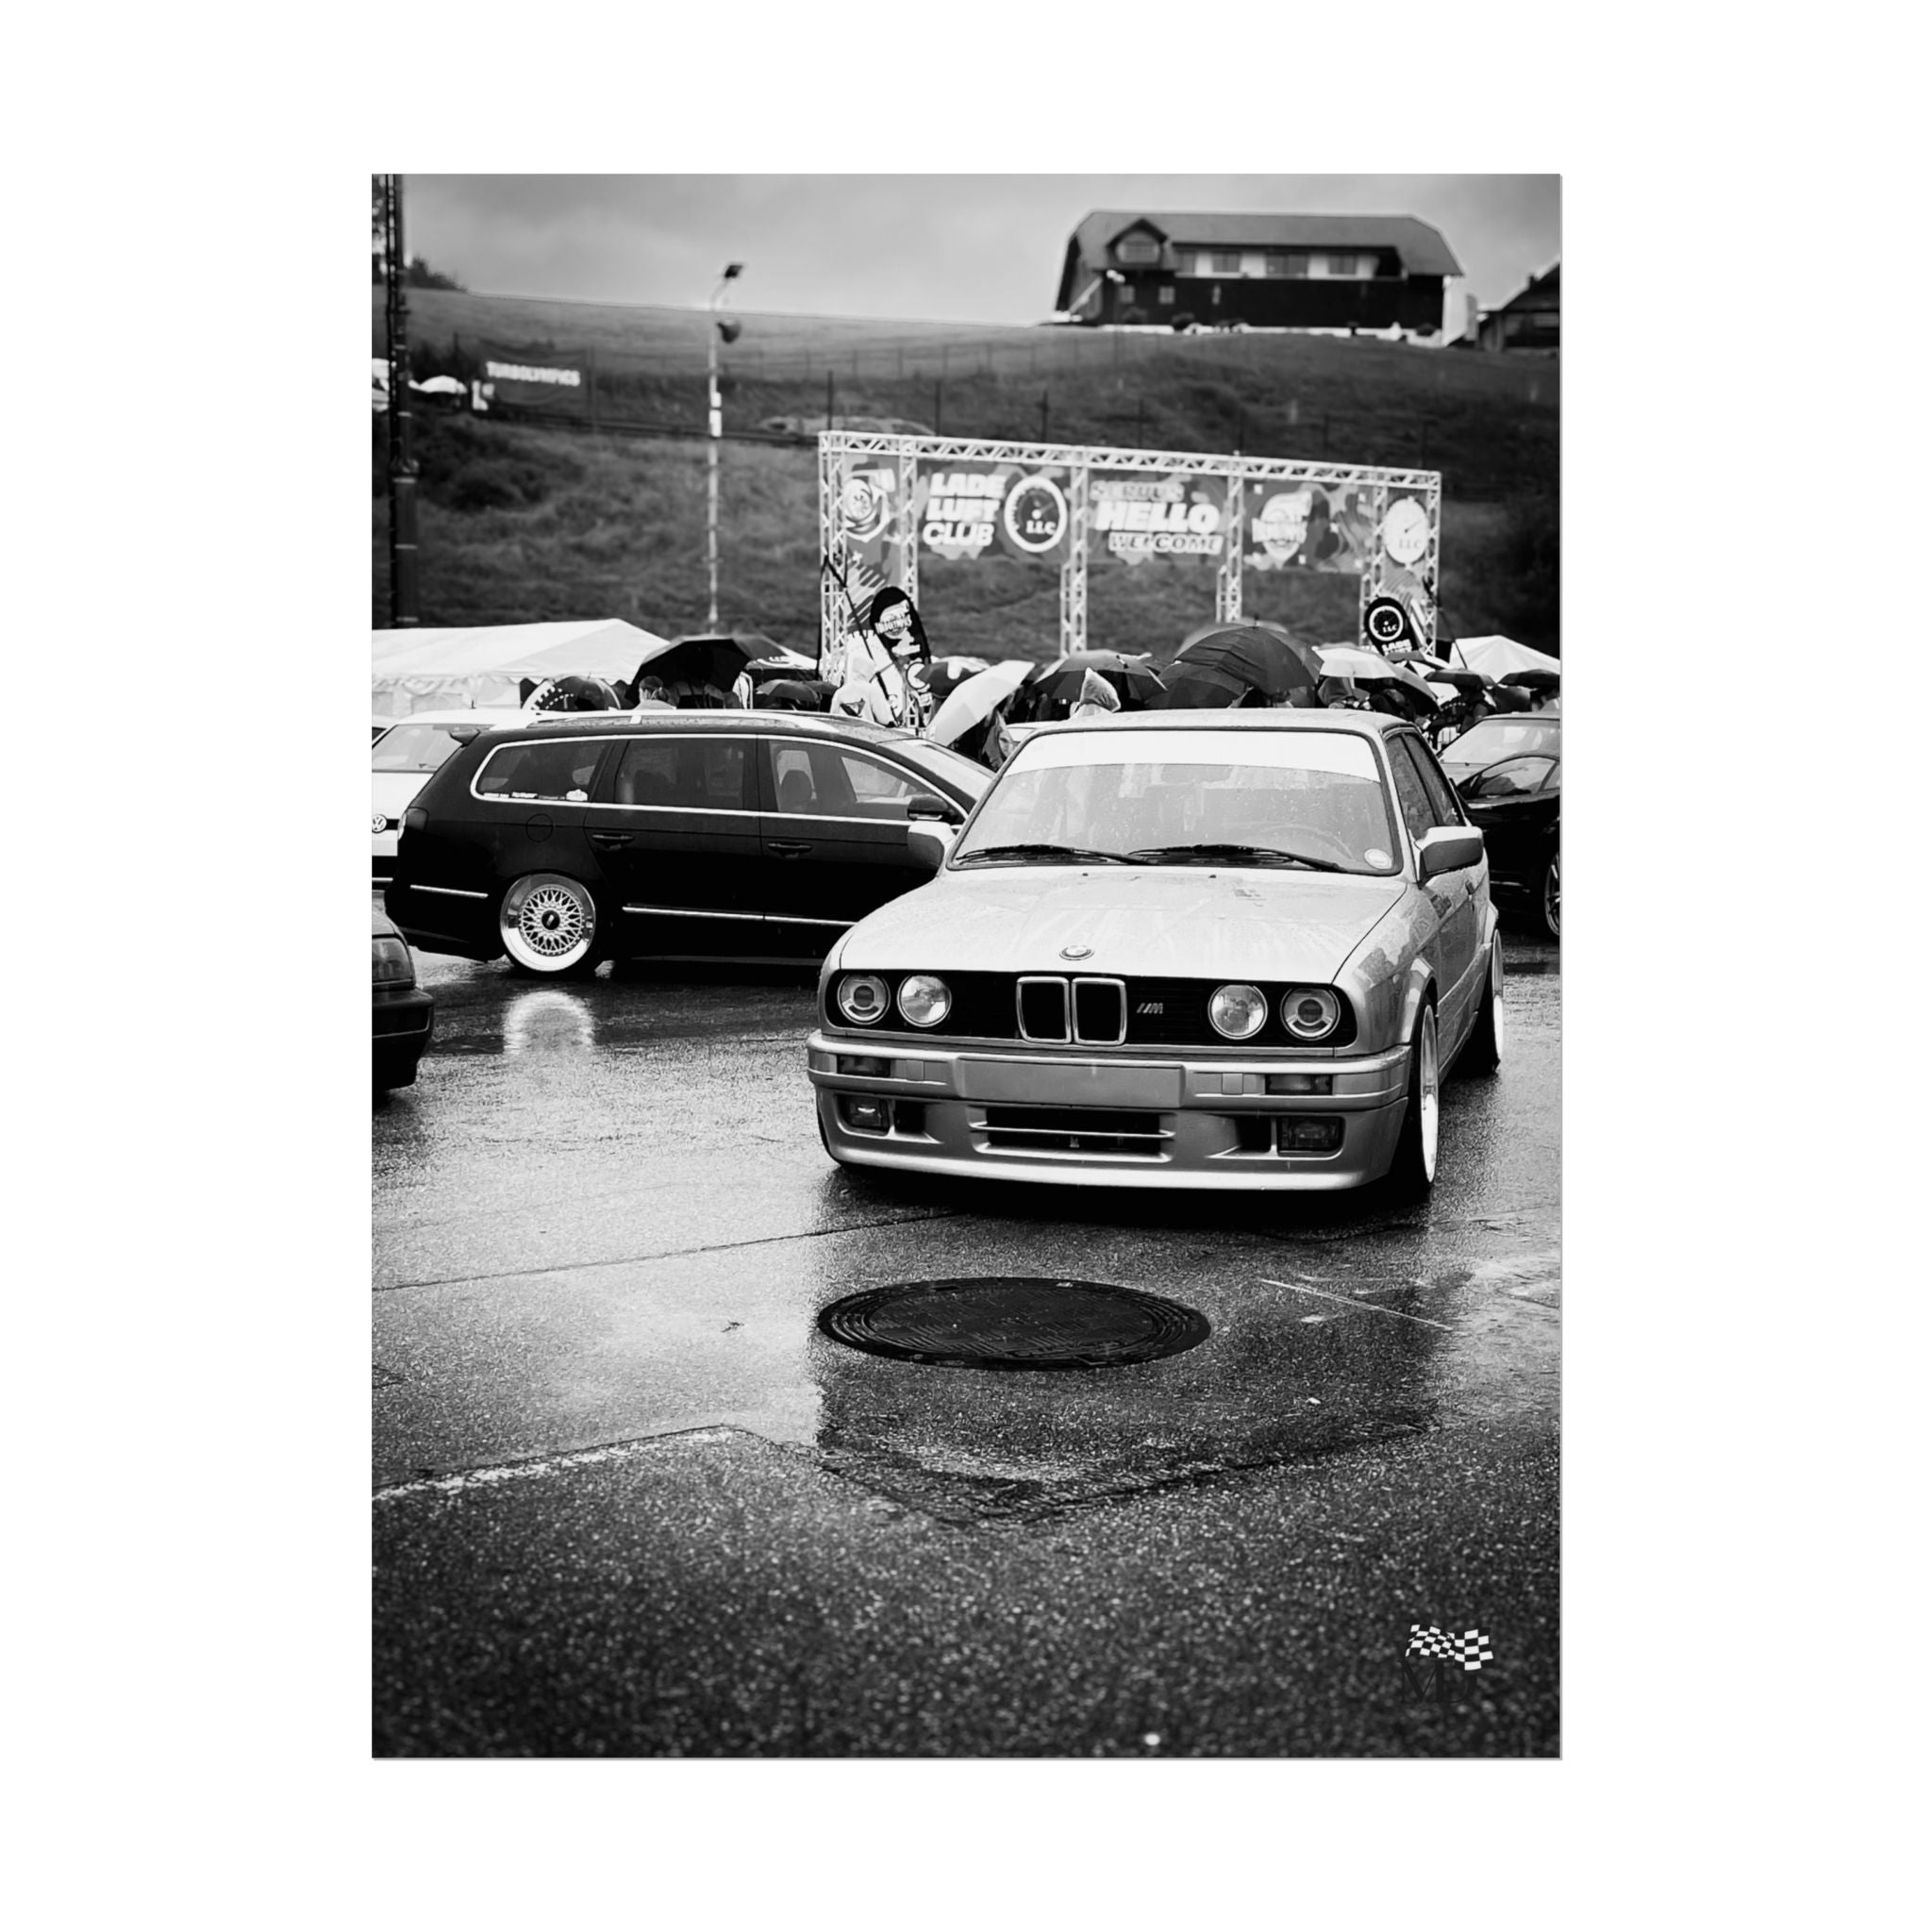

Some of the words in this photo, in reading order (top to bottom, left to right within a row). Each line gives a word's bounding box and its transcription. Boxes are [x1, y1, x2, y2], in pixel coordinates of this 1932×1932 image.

[929, 473, 1006, 500] LADE
[925, 498, 1000, 523] LUFT
[1095, 501, 1220, 534] HELLO
[922, 522, 995, 546] CLUB
[1025, 520, 1056, 535] LLC
[1109, 533, 1223, 555] WELCOME
